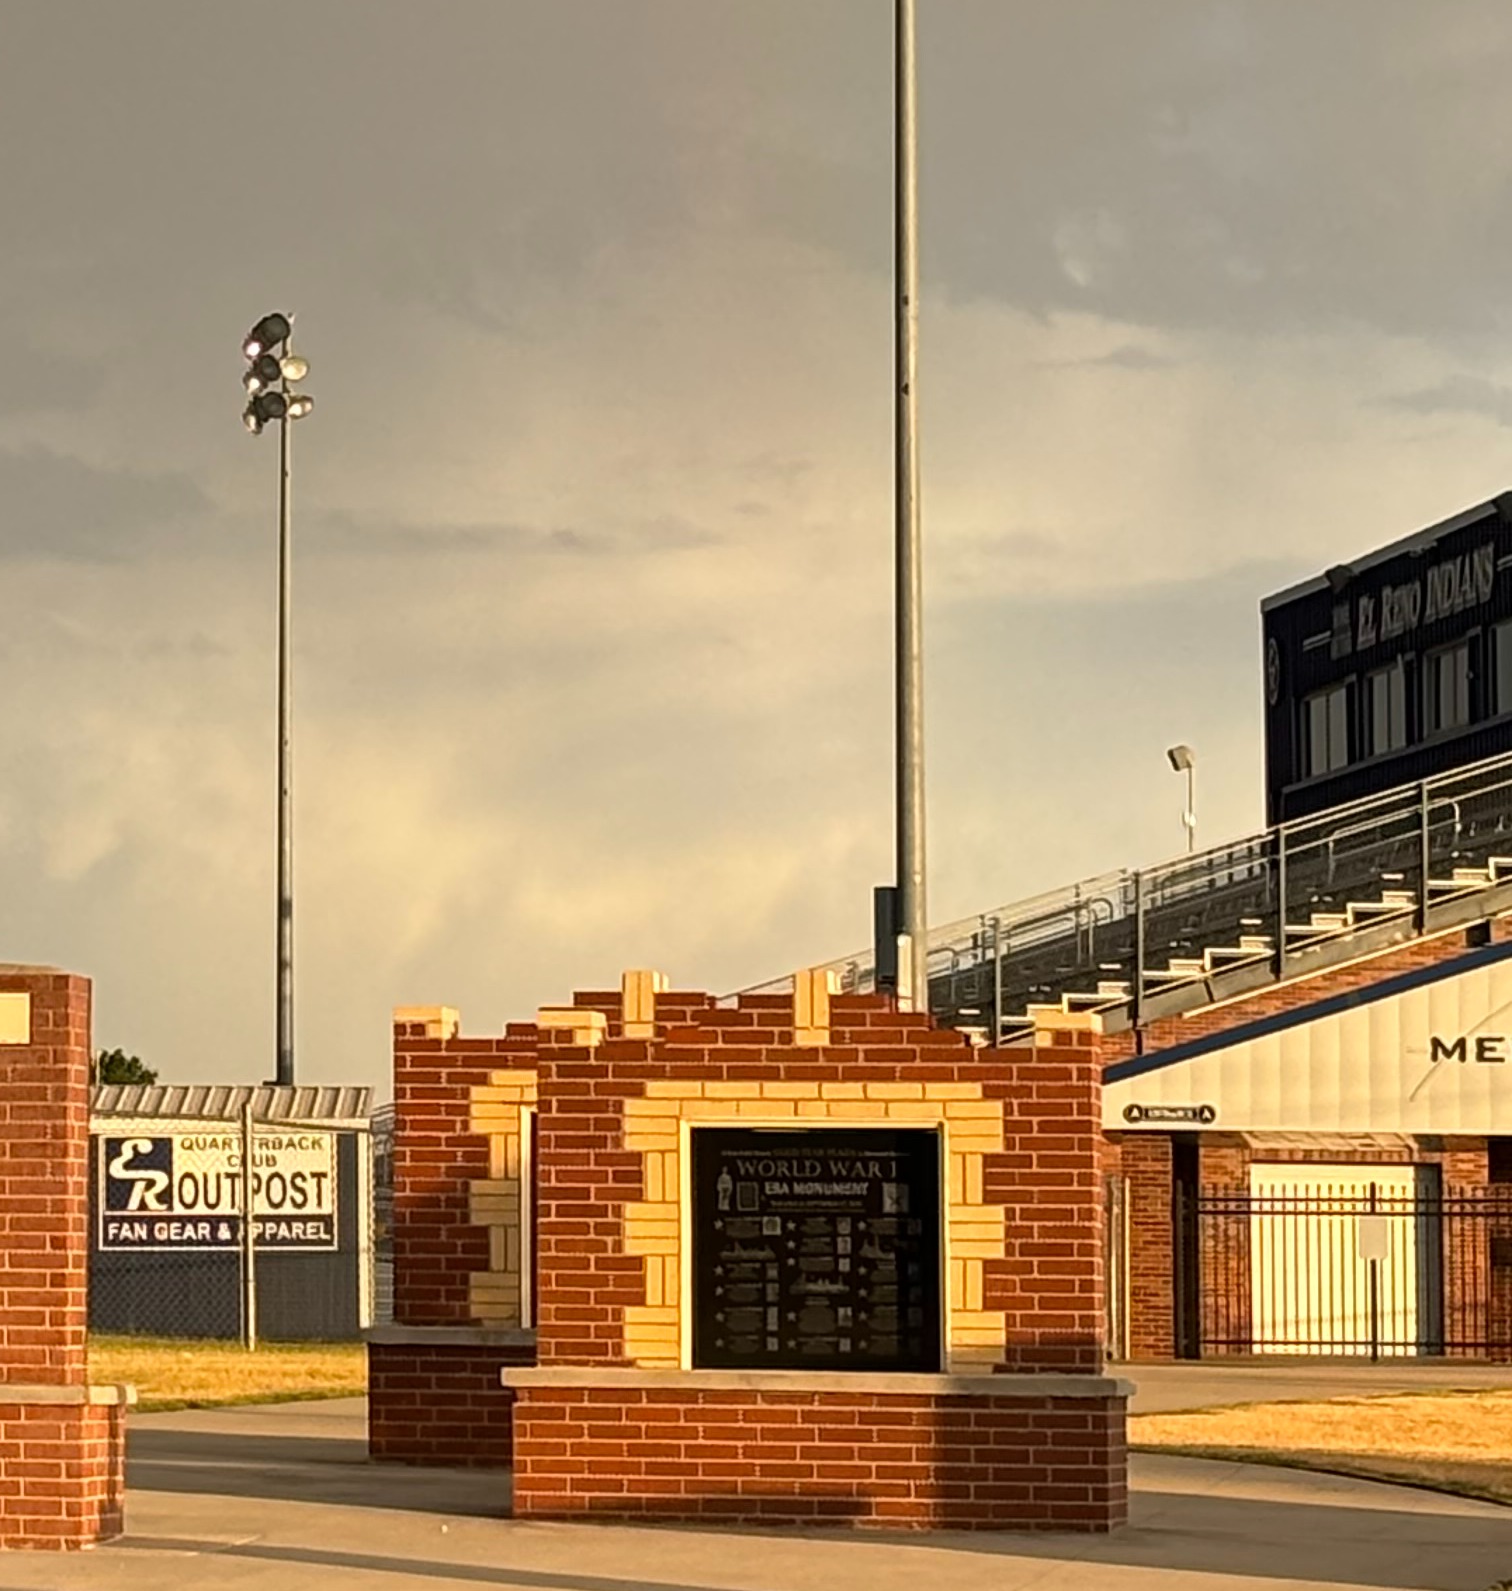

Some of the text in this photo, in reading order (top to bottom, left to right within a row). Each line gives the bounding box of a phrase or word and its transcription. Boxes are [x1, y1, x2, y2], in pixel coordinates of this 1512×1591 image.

[1379, 579, 1421, 642] RENO
[1423, 541, 1495, 625] INDIANS
[227, 1154, 278, 1168] CUB
[736, 1159, 822, 1178] WORLD
[828, 1159, 883, 1178] WAR
[793, 1182, 870, 1196] MONUMENT
[107, 1222, 148, 1241] FAN
[154, 1222, 210, 1241] GEAR
[217, 1222, 232, 1241] &
